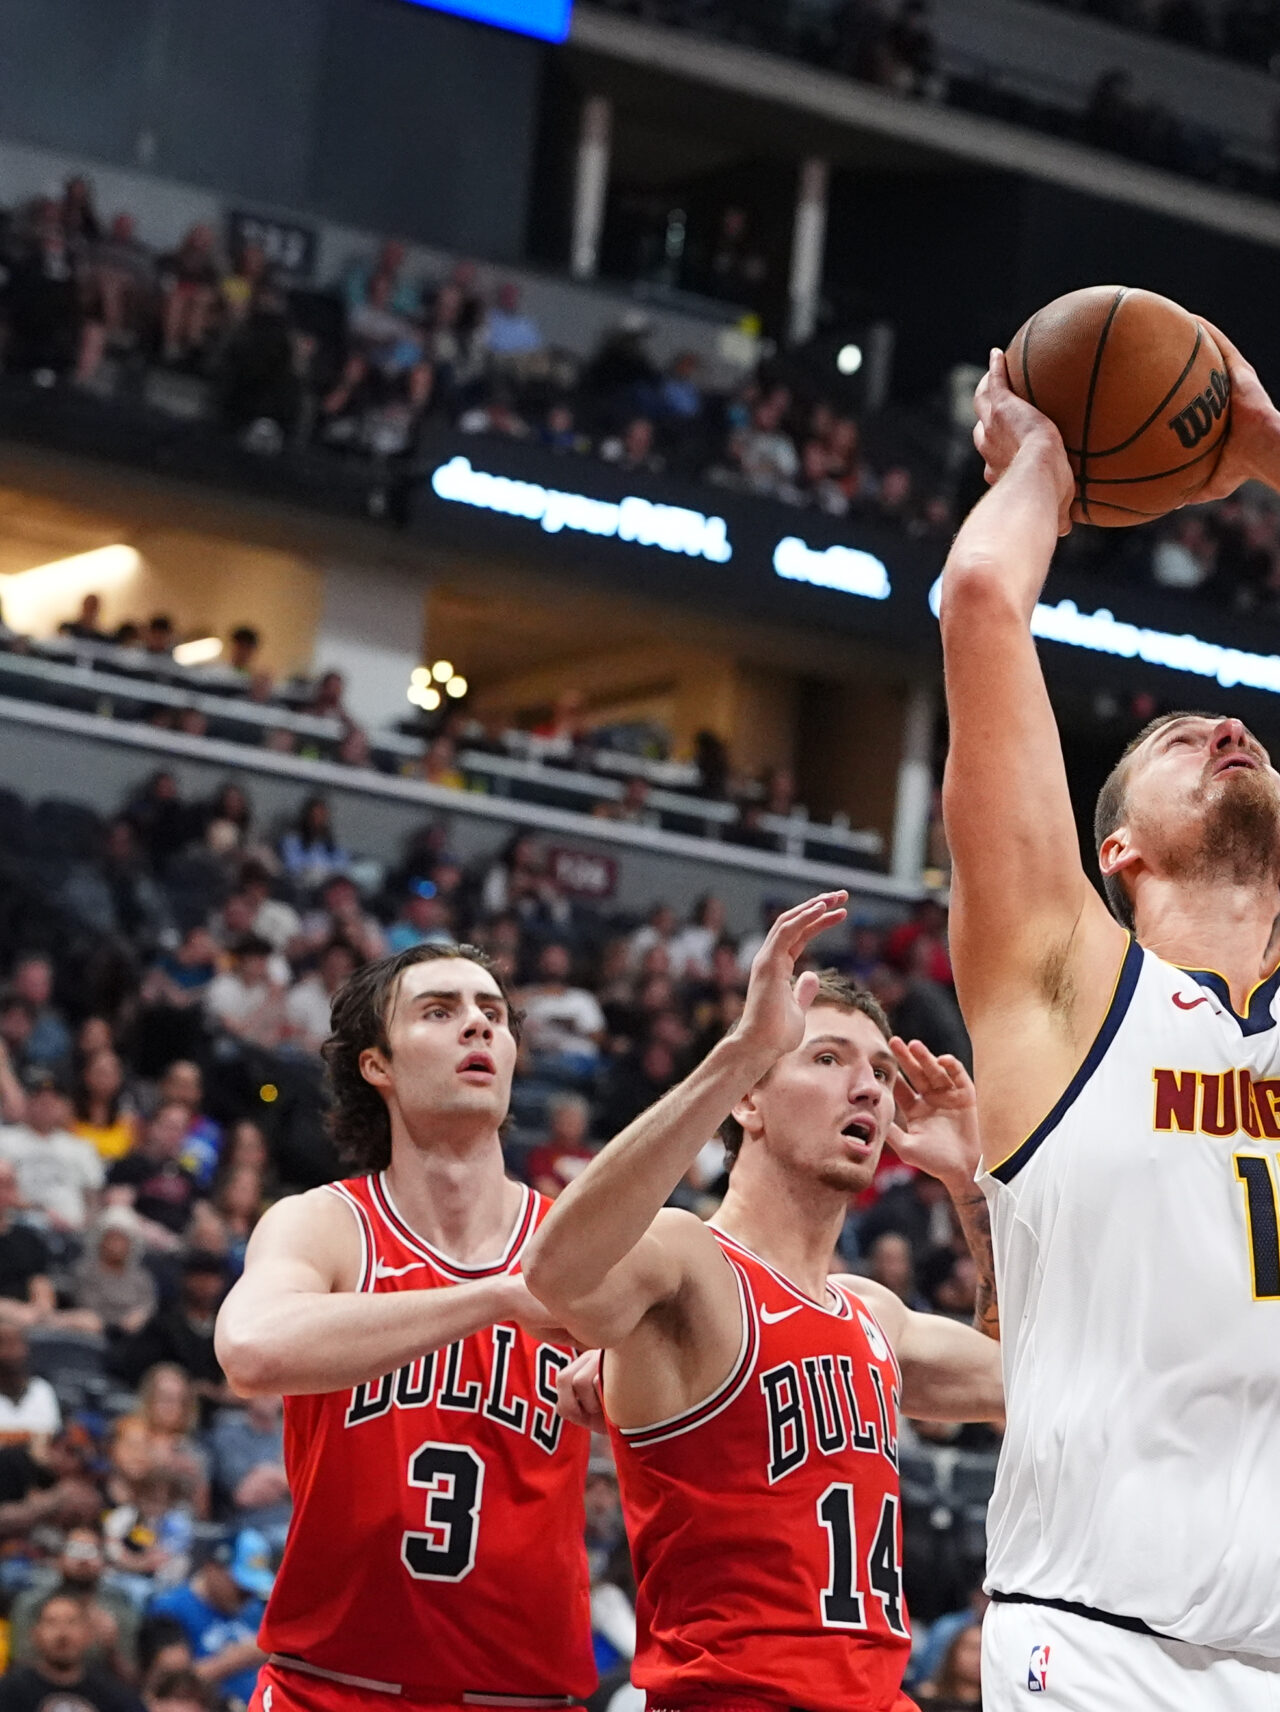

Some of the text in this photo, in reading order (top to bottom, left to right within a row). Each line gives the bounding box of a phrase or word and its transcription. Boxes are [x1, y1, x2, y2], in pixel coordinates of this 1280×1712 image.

[760, 1355, 901, 1486] BULL
[401, 1440, 485, 1583] 3
[816, 1482, 911, 1640] 14
